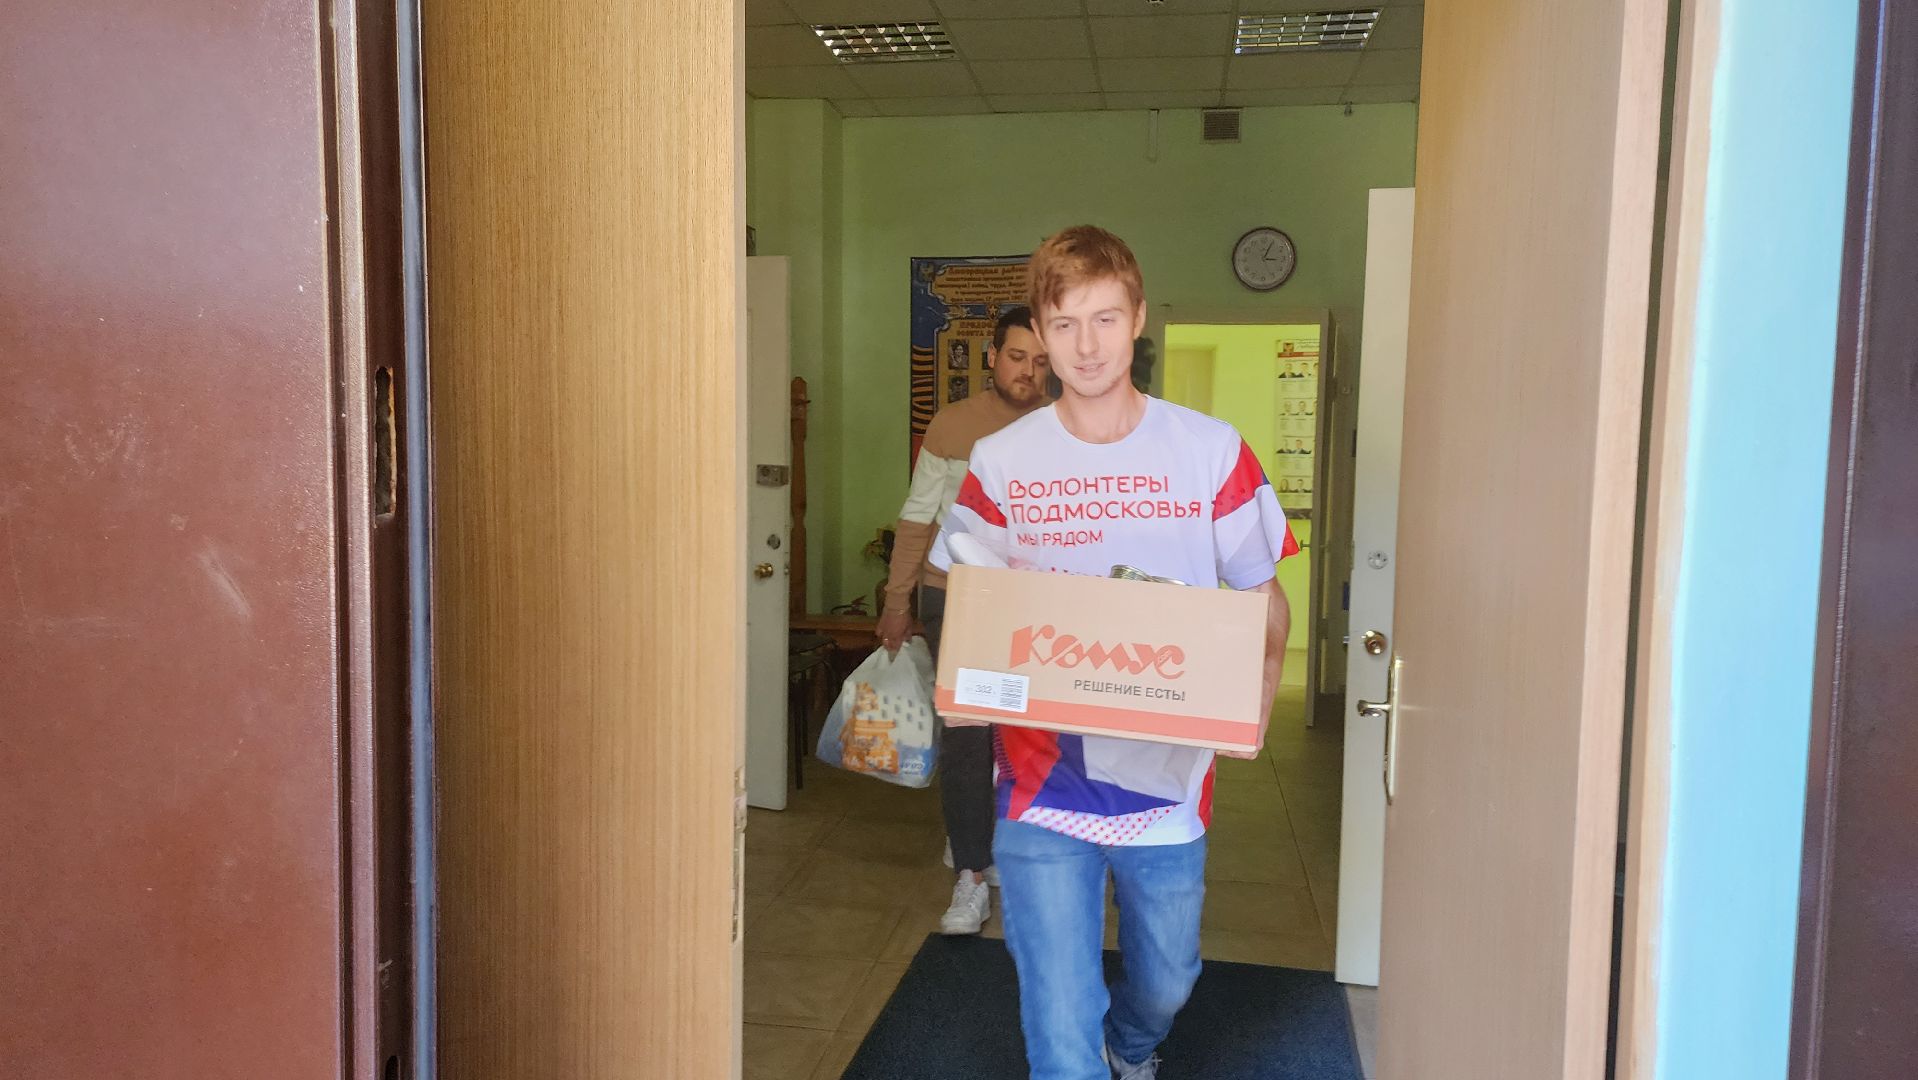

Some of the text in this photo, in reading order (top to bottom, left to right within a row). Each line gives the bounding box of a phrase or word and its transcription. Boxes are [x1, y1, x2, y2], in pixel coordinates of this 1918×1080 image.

[1008, 475, 1169, 499] ВОЛОНТЕРЫ
[1010, 500, 1201, 524] ПОДМОСКОВЬЯ
[1016, 530, 1103, 547] МЫ РЯДОМ
[1073, 679, 1186, 702] РЕШЕНИЕ ЕСТЬ!
